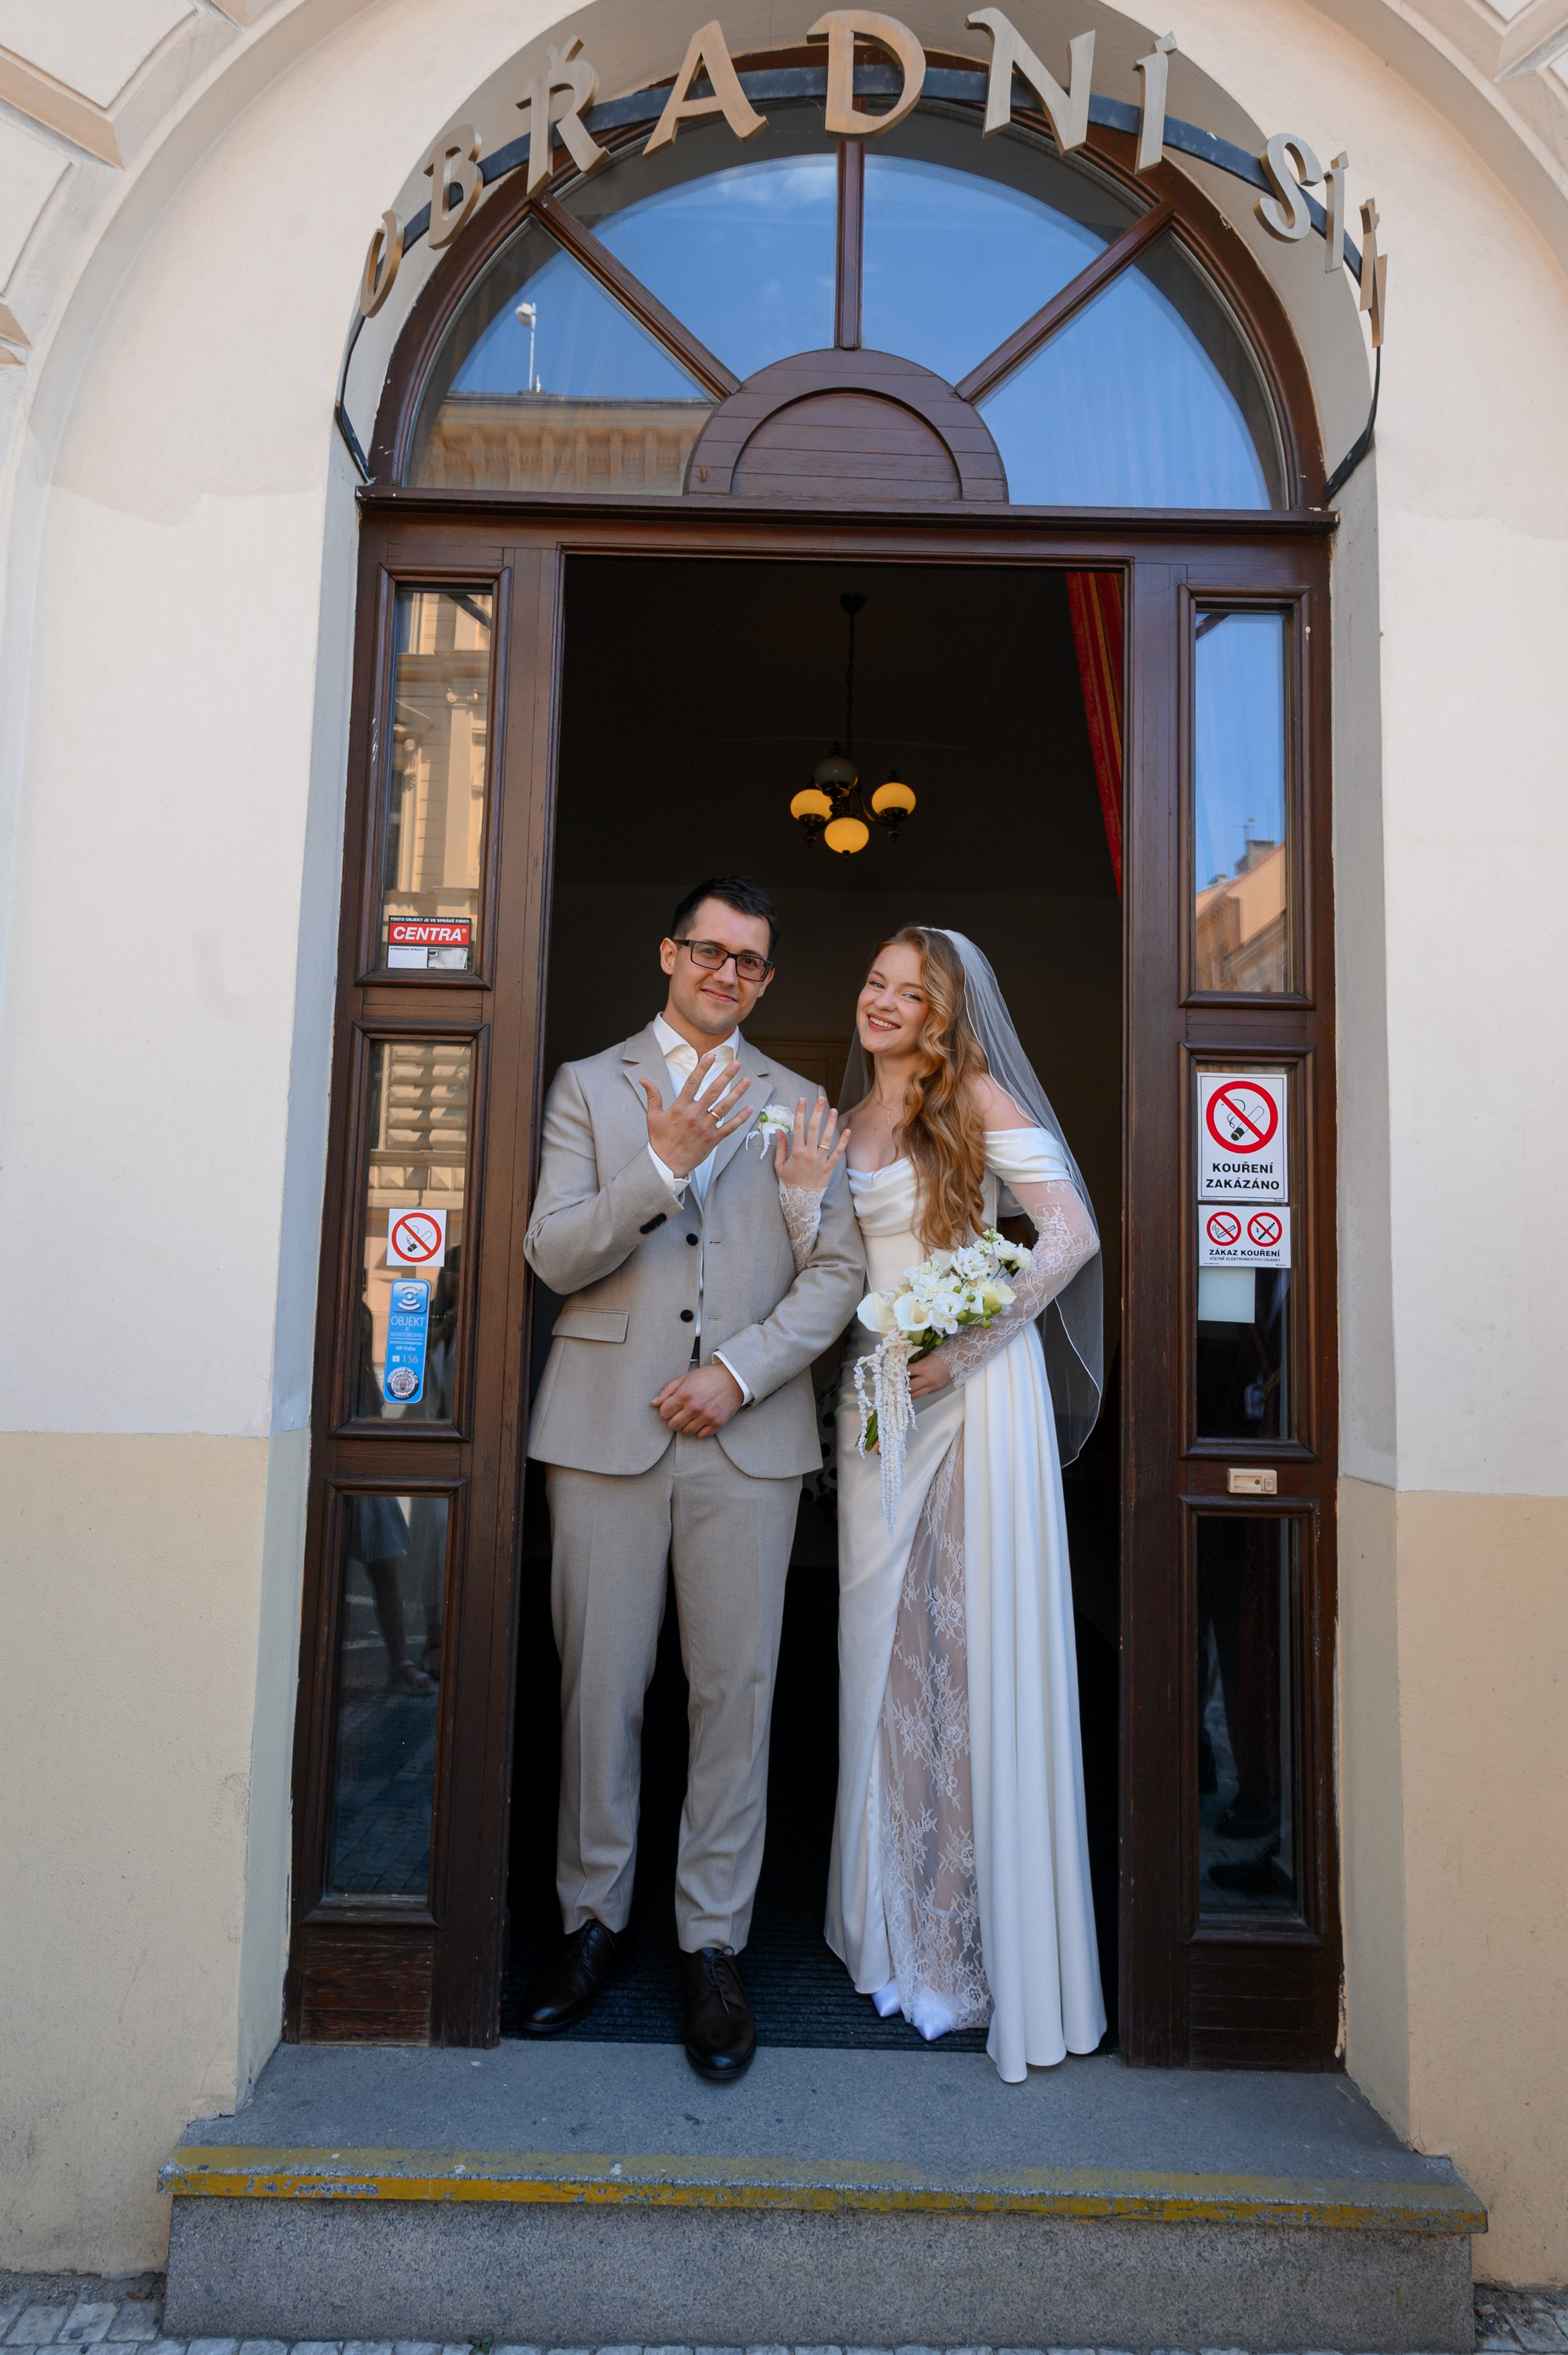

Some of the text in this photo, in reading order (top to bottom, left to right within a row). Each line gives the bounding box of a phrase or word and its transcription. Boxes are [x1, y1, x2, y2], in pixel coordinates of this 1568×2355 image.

[360, 7, 1178, 318] OBŘADNÍ
[1212, 1161, 1273, 1174] KOUŘENÍ
[1205, 1177, 1280, 1190] ZAKÁZÁNO
[1241, 1249, 1281, 1257] KOUŘENÍ
[391, 1316, 425, 1327] OBJEKT
[402, 1354, 418, 1364] 156
